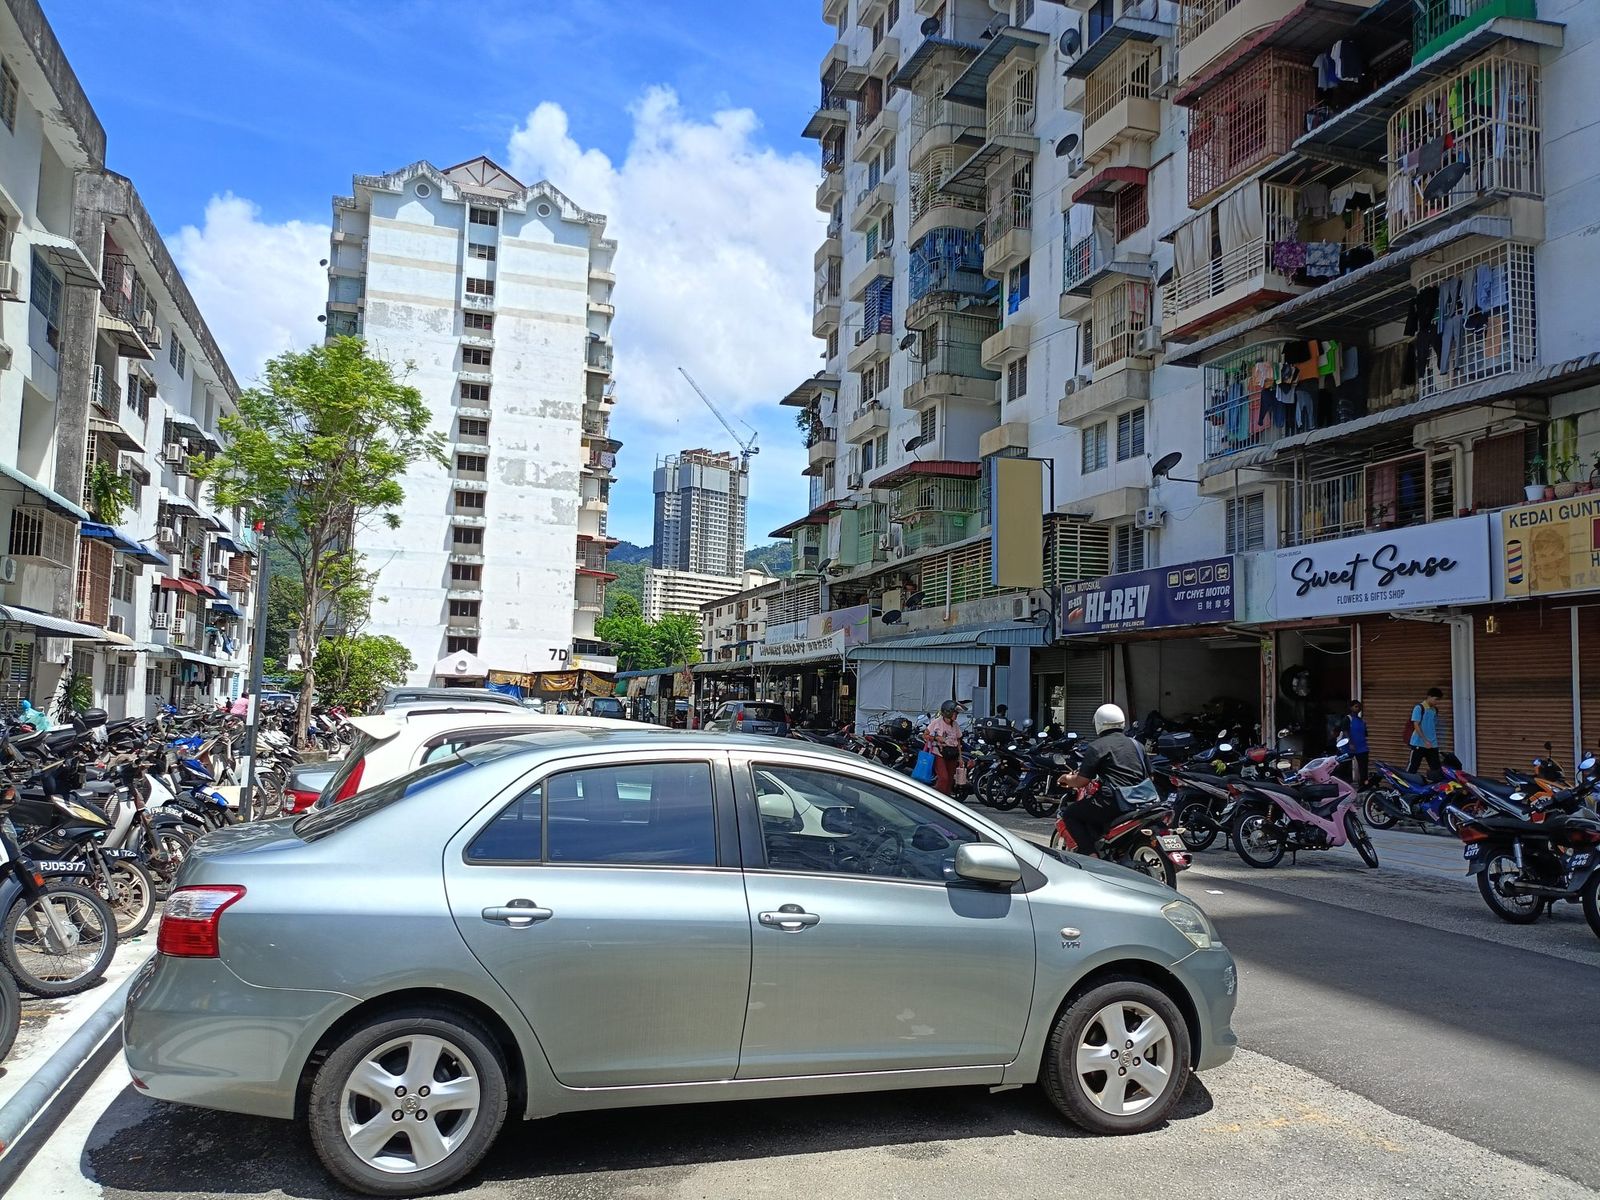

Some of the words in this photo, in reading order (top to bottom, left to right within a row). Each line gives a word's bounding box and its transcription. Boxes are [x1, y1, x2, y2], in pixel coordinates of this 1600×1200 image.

[1509, 507, 1552, 528] KEDAI
[1291, 553, 1368, 597] Sweet
[1372, 543, 1457, 587] Sense
[1174, 591, 1186, 601] JIT
[1186, 588, 1205, 600] CHYE
[1205, 585, 1231, 597] MOTOR
[1336, 592, 1363, 605] FLOWERS
[1364, 593, 1370, 602] &
[1370, 590, 1388, 602] GIFTS
[1388, 588, 1405, 600] SHOP
[1084, 584, 1150, 623] HI-REV
[548, 648, 568, 661] 7D
[40, 861, 86, 872] PJD5377
